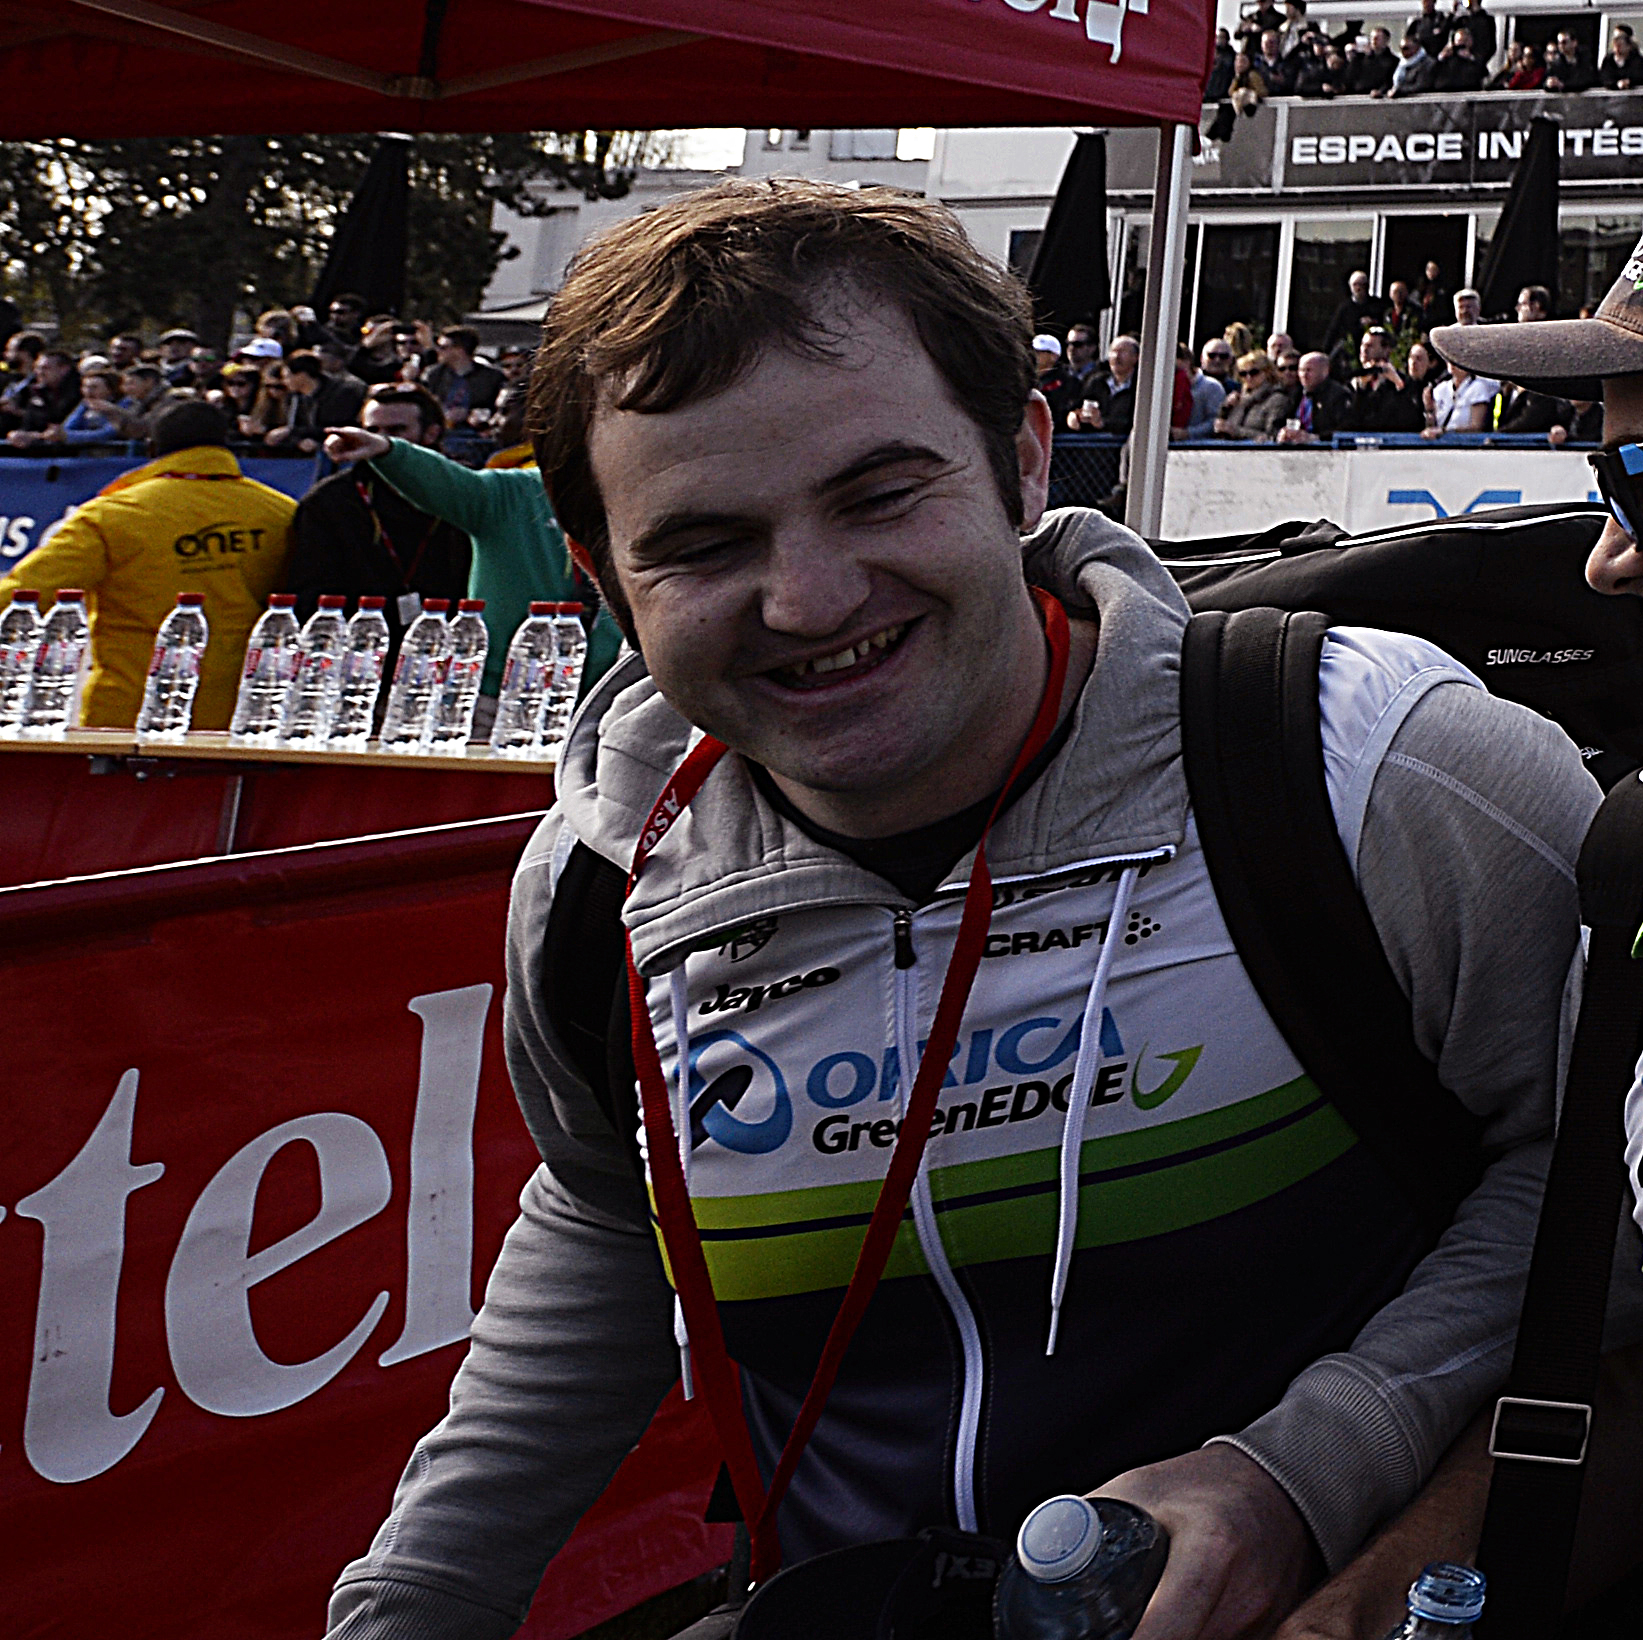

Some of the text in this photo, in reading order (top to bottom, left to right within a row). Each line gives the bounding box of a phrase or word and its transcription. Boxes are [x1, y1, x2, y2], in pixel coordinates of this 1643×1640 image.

[1291, 134, 1462, 166] ESPACE
[1486, 648, 1595, 666] SUNGLASSES
[698, 966, 841, 1016] Jayco
[0, 983, 494, 1484] tel
